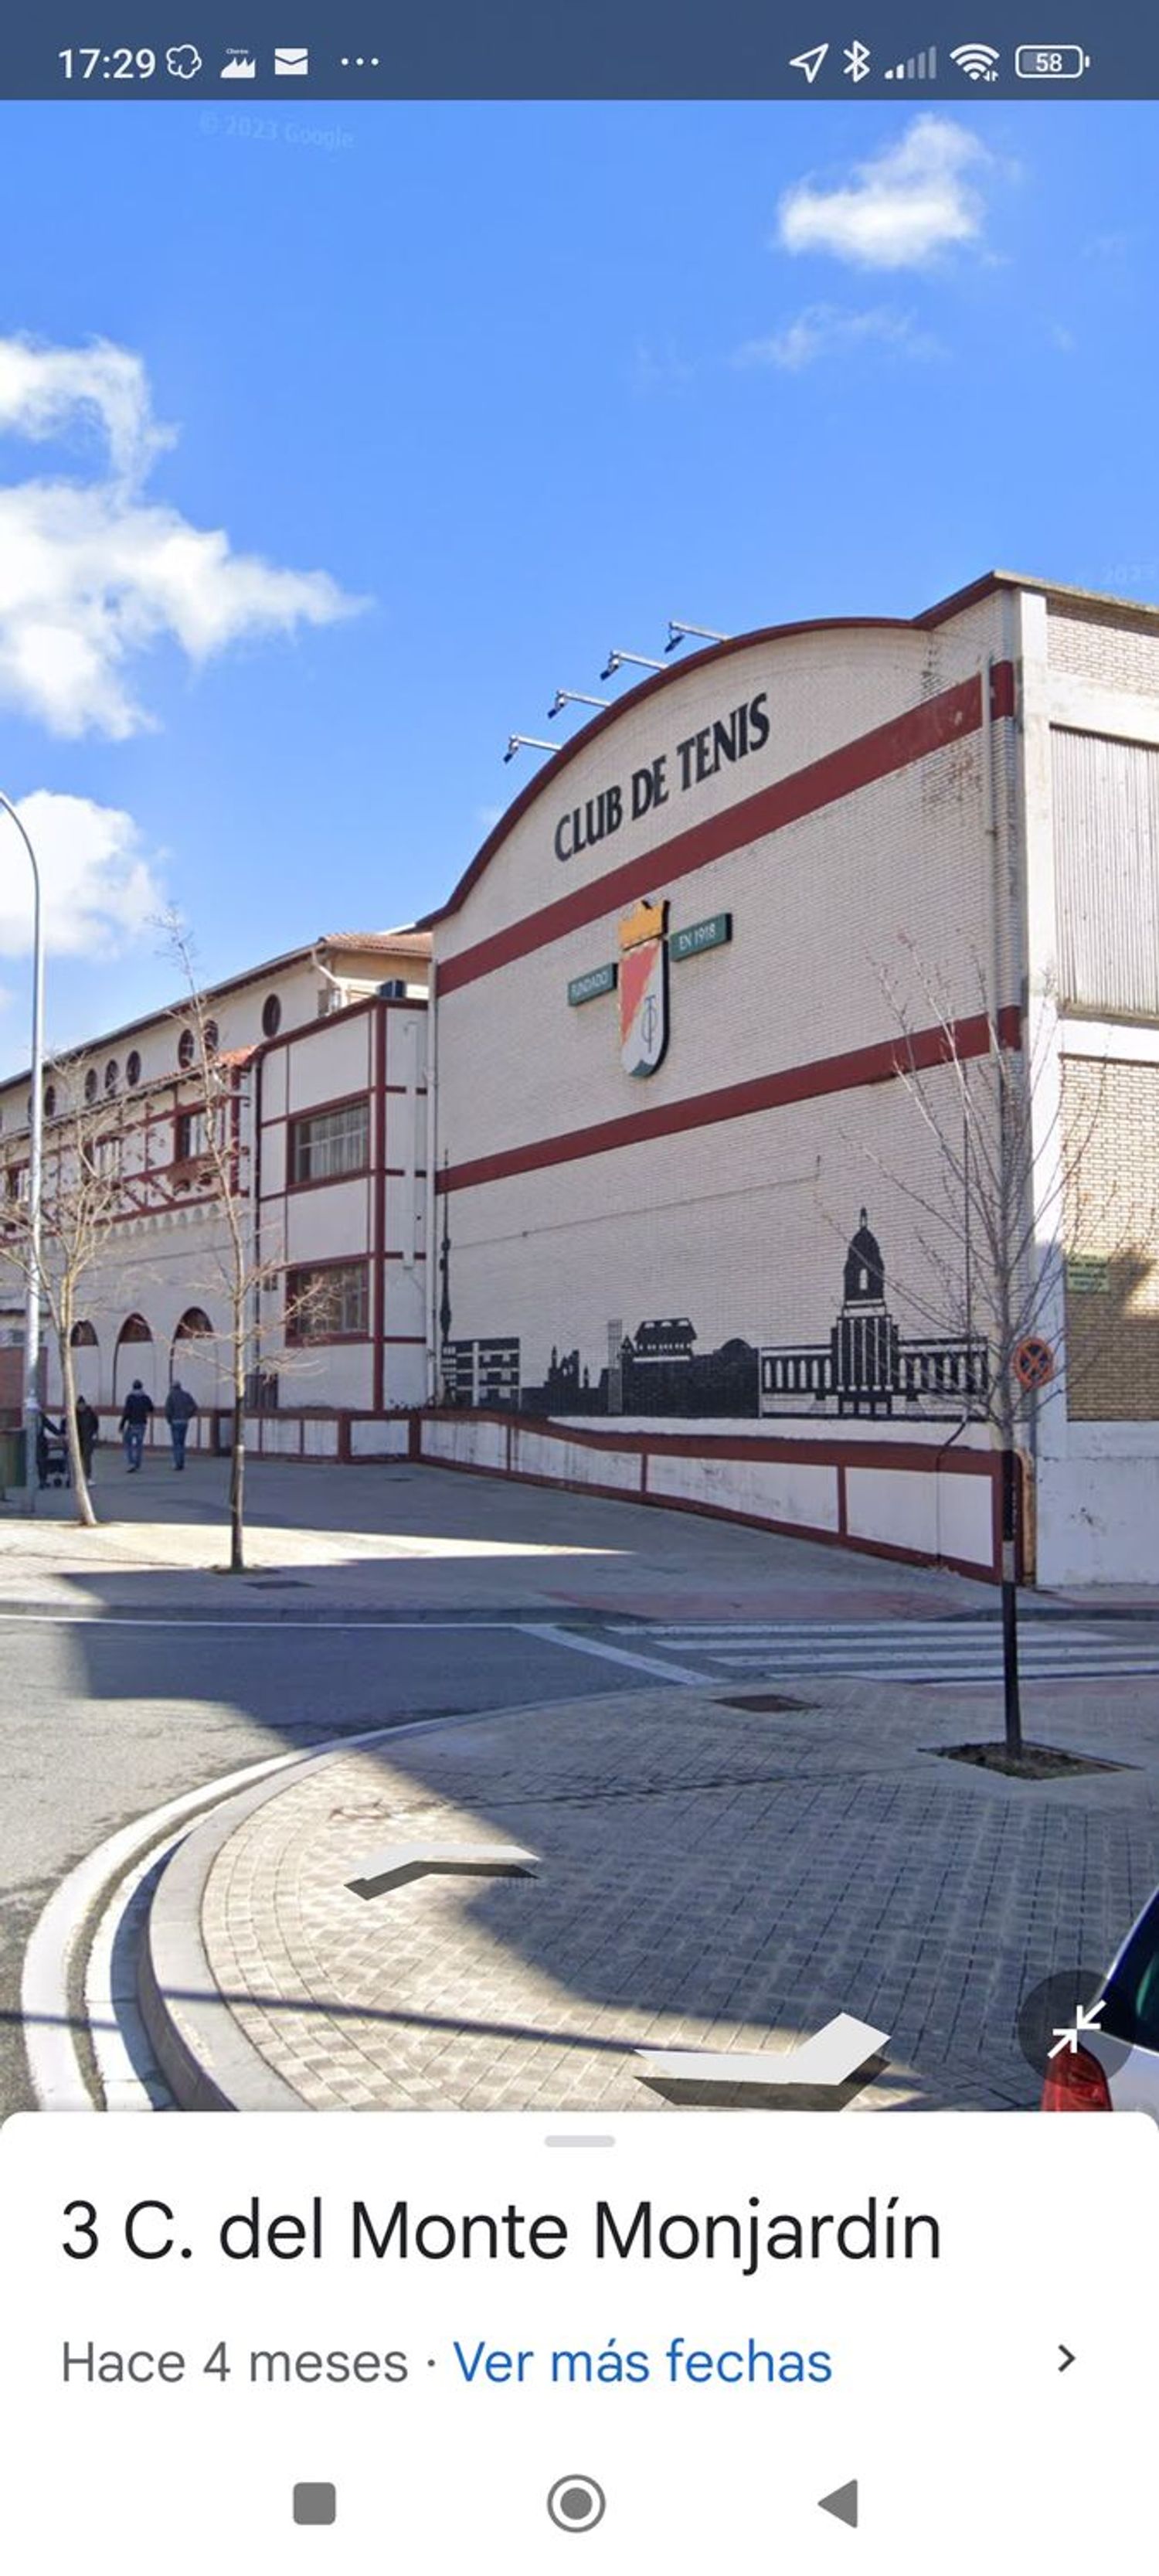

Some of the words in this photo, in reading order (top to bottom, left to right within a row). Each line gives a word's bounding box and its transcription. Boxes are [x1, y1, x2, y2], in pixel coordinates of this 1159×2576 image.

[554, 784, 623, 863] CLUB
[631, 754, 669, 821] DE
[676, 692, 770, 791] TENIS
[679, 931, 693, 951] EN
[694, 923, 716, 947] 1918
